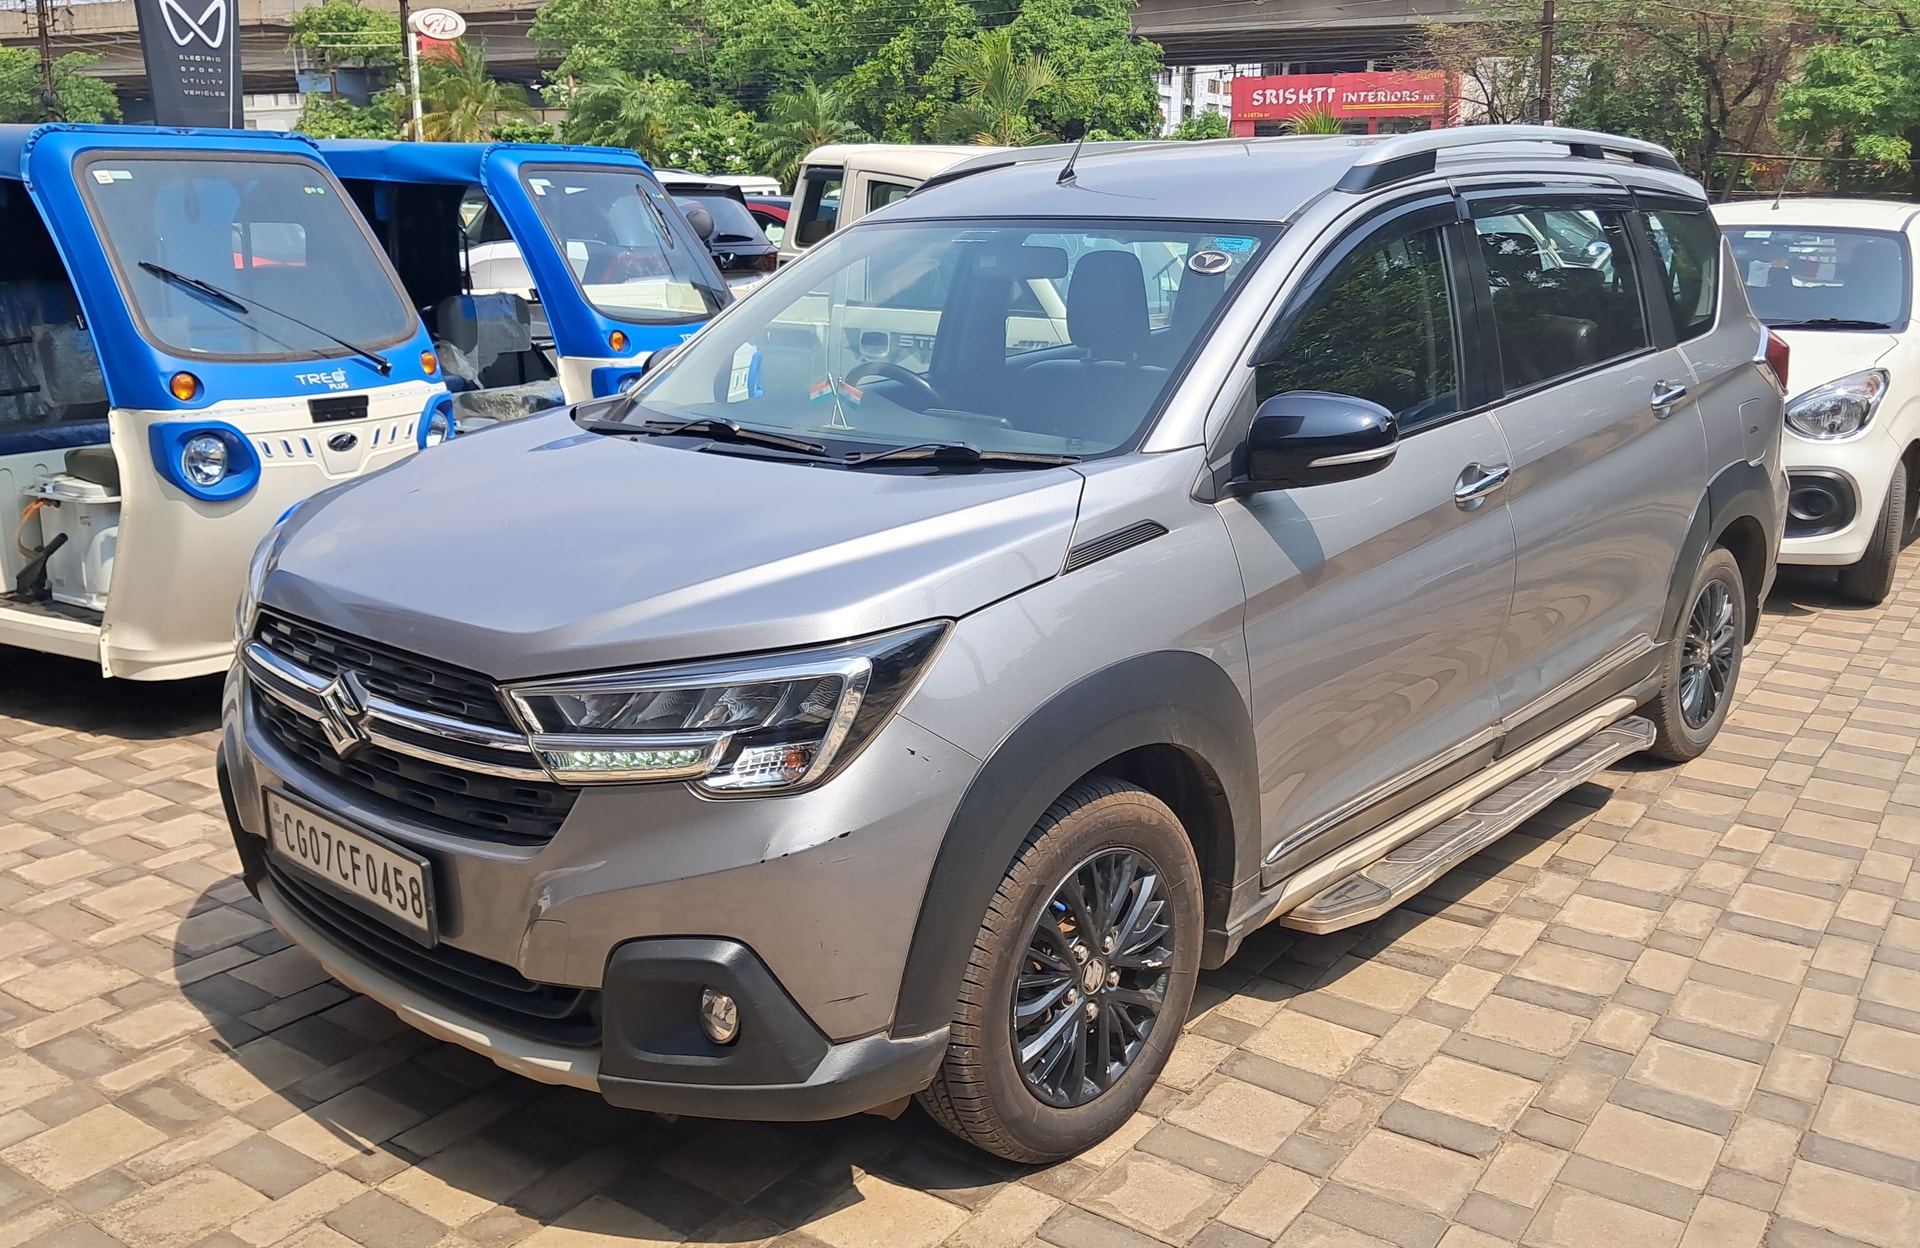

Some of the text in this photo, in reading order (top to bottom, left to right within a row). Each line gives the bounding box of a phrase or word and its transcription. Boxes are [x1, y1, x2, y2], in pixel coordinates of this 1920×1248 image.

[179, 54, 221, 62] ELECTRIC
[183, 89, 225, 97] VEHICLES
[1252, 87, 1336, 105] SRISHTI
[1342, 90, 1420, 102] INTERIORS
[283, 813, 423, 919] CG07CF0458
